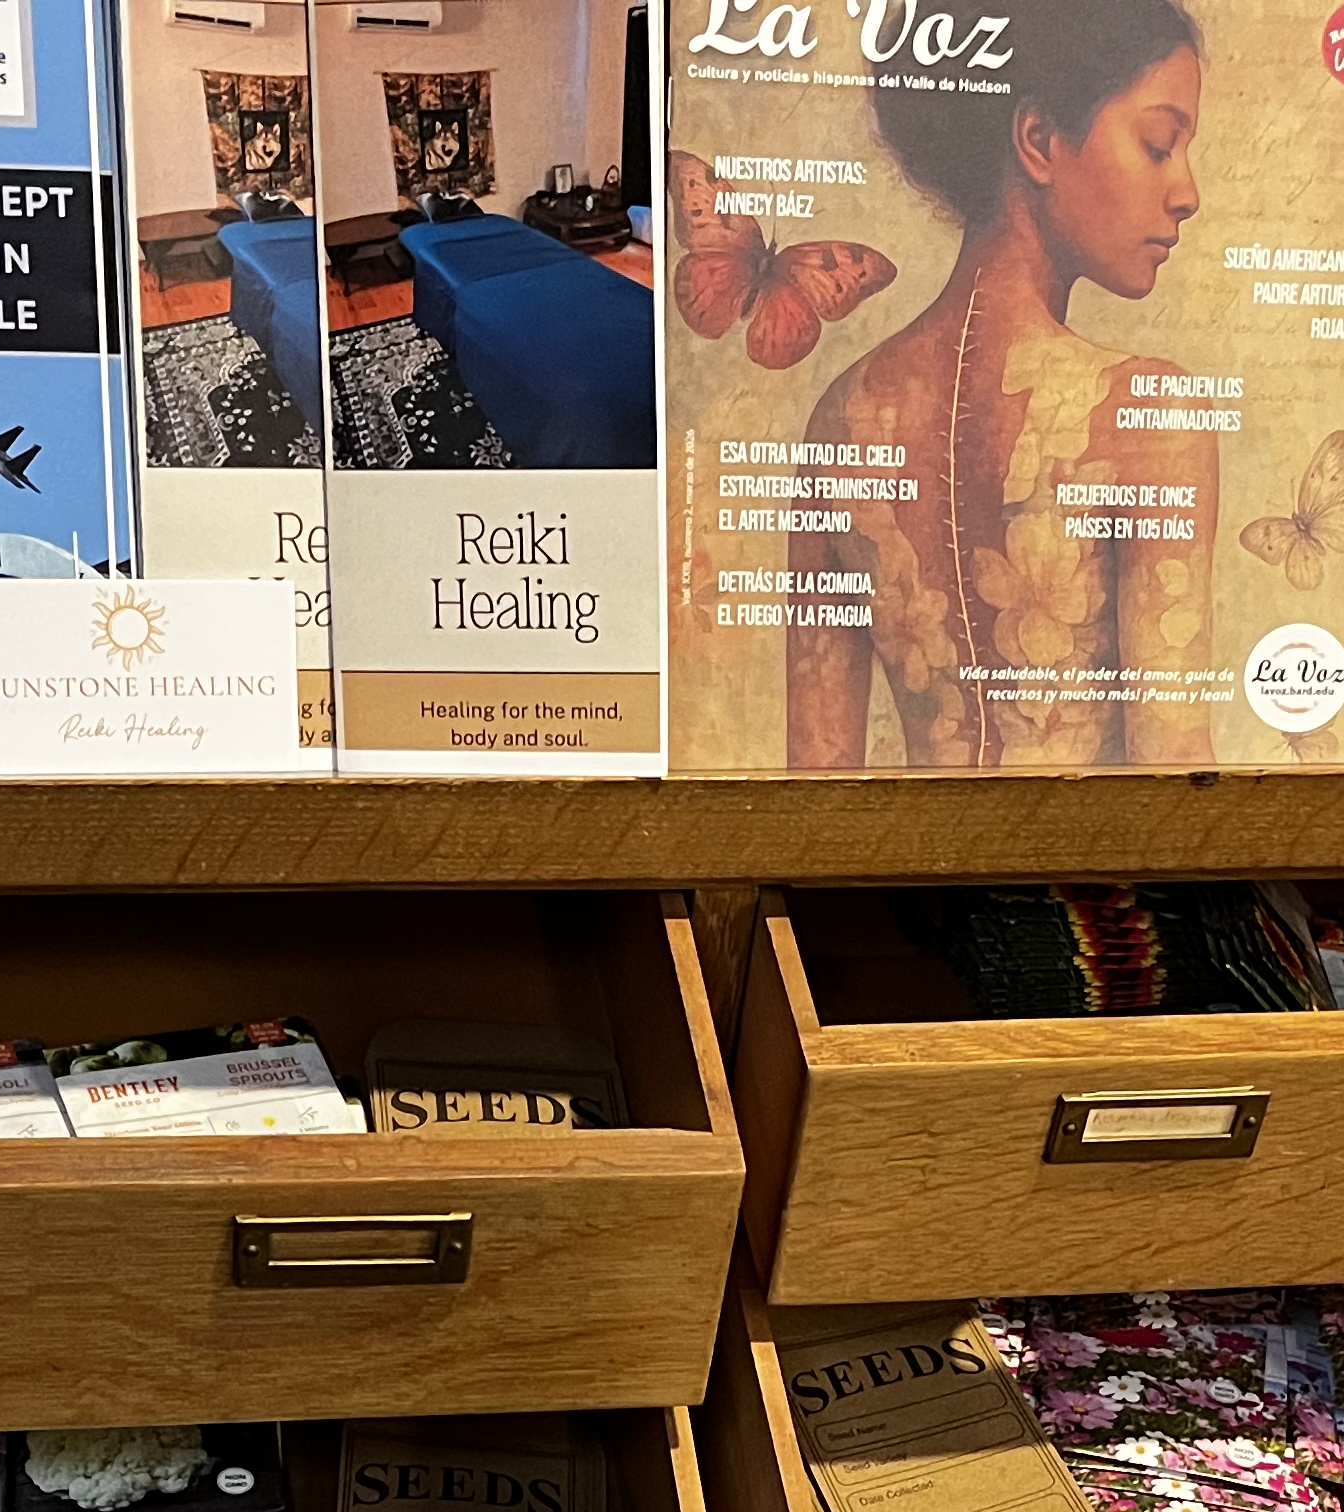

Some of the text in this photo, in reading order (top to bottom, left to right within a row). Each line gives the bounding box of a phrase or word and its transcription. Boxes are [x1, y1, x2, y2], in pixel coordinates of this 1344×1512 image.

[688, 0, 1014, 69] La Voz
[714, 156, 867, 184] NUESTROS ARTISTAS:
[714, 190, 814, 218] ANNECY BÁEZ
[1224, 243, 1271, 270] SUEÑO
[1254, 282, 1298, 304] PADRE
[456, 511, 571, 565] Reiki
[431, 579, 600, 642] Healing
[1252, 659, 1344, 684] La Voz
[150, 675, 276, 698] HEALING
[1261, 687, 1334, 696] lavoz.bard.edu
[420, 701, 624, 722] Healing for the mind,
[124, 711, 209, 749] Healing
[450, 728, 588, 751] body and soul.
[227, 1056, 300, 1074] BRUSSEL
[229, 1069, 306, 1086] SPROUTS
[87, 1078, 179, 1102] BENTLEY
[391, 1089, 605, 1130] SEEDS
[791, 1339, 986, 1417] SEEDS
